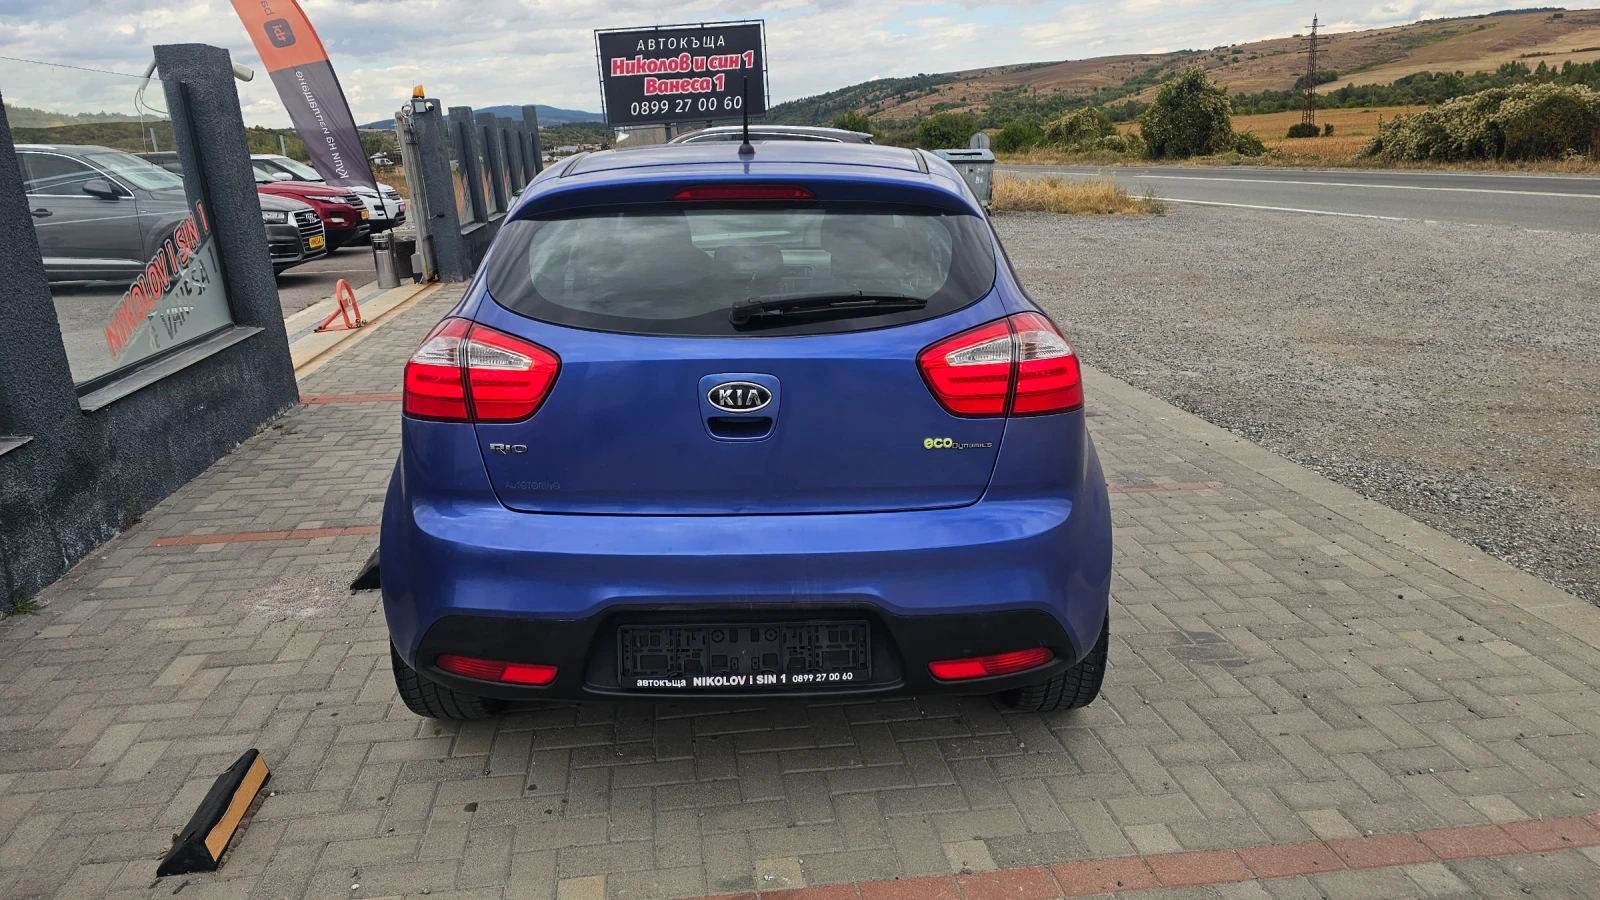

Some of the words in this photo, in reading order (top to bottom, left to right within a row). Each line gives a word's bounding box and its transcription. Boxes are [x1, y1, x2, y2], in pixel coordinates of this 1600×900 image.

[637, 35, 726, 50] АВТОКЪЩА
[611, 52, 692, 76] Николов
[693, 56, 706, 72] и
[707, 54, 741, 71] син
[742, 50, 754, 68] 1
[644, 77, 712, 96] Ванеса
[713, 73, 725, 91] 1
[631, 100, 669, 115] 0899
[675, 99, 692, 113] 27
[698, 97, 717, 111] 00
[724, 95, 742, 110] 60
[104, 249, 170, 358] NIKOLOV
[174, 213, 201, 265] SIN
[196, 200, 209, 233] 1
[718, 389, 762, 406] KIA
[489, 443, 528, 455] RIO
[636, 678, 687, 688] автокъща
[693, 675, 746, 686] NIKOLOV
[749, 675, 753, 685] i
[756, 675, 777, 684] SIN
[780, 674, 787, 684] 1
[792, 674, 813, 683] 0899
[816, 673, 827, 682] 27
[828, 673, 840, 681] 00
[842, 672, 853, 681] 60
